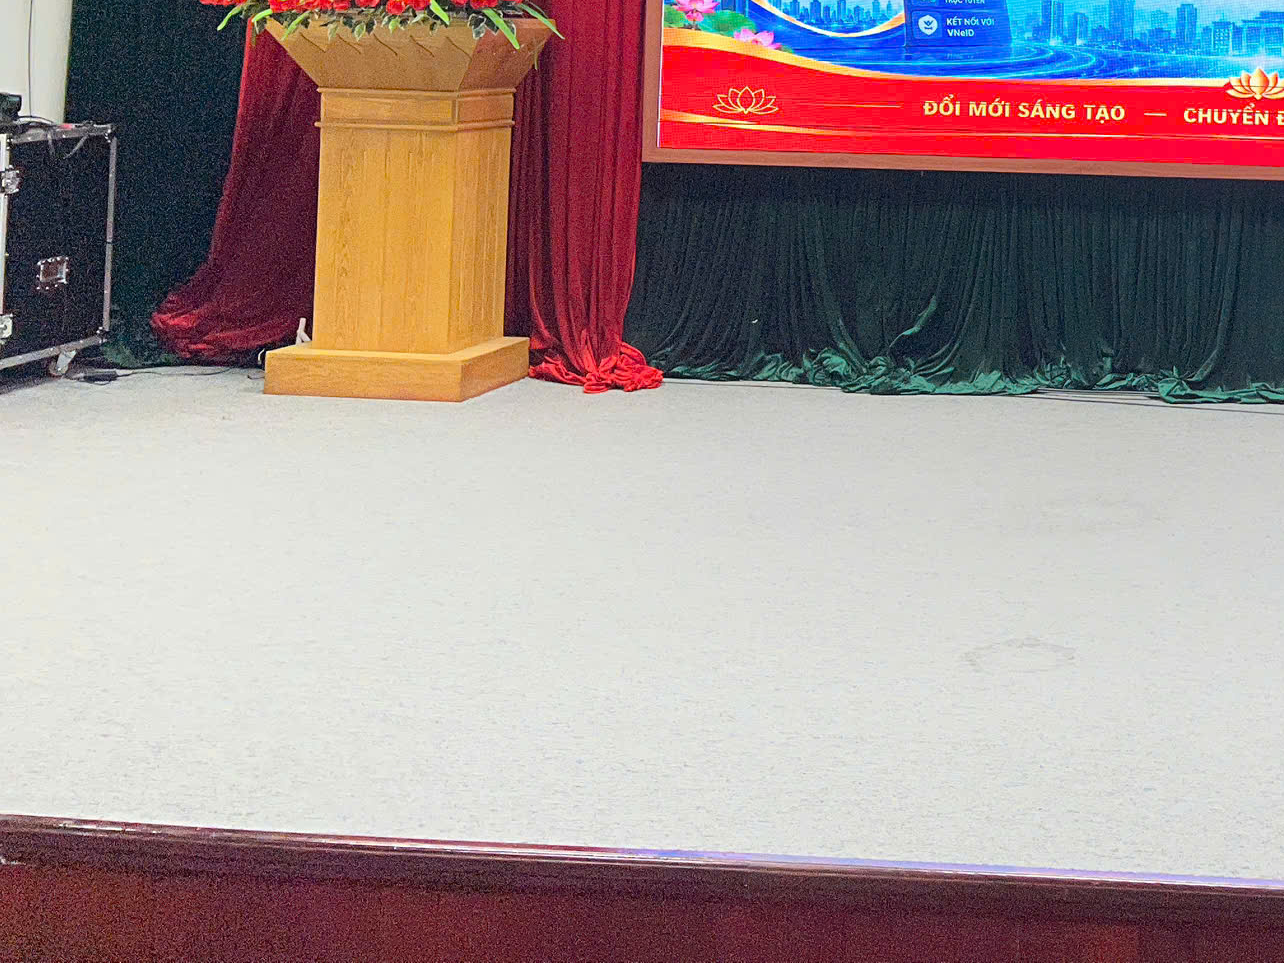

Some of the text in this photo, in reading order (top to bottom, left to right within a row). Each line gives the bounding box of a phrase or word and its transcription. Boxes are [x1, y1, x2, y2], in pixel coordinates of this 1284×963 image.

[947, 29, 975, 37] VNeID
[923, 93, 1125, 124] ĐỔI MỚI SÁNG TẠO
[1183, 102, 1269, 126] CHUYỂN
